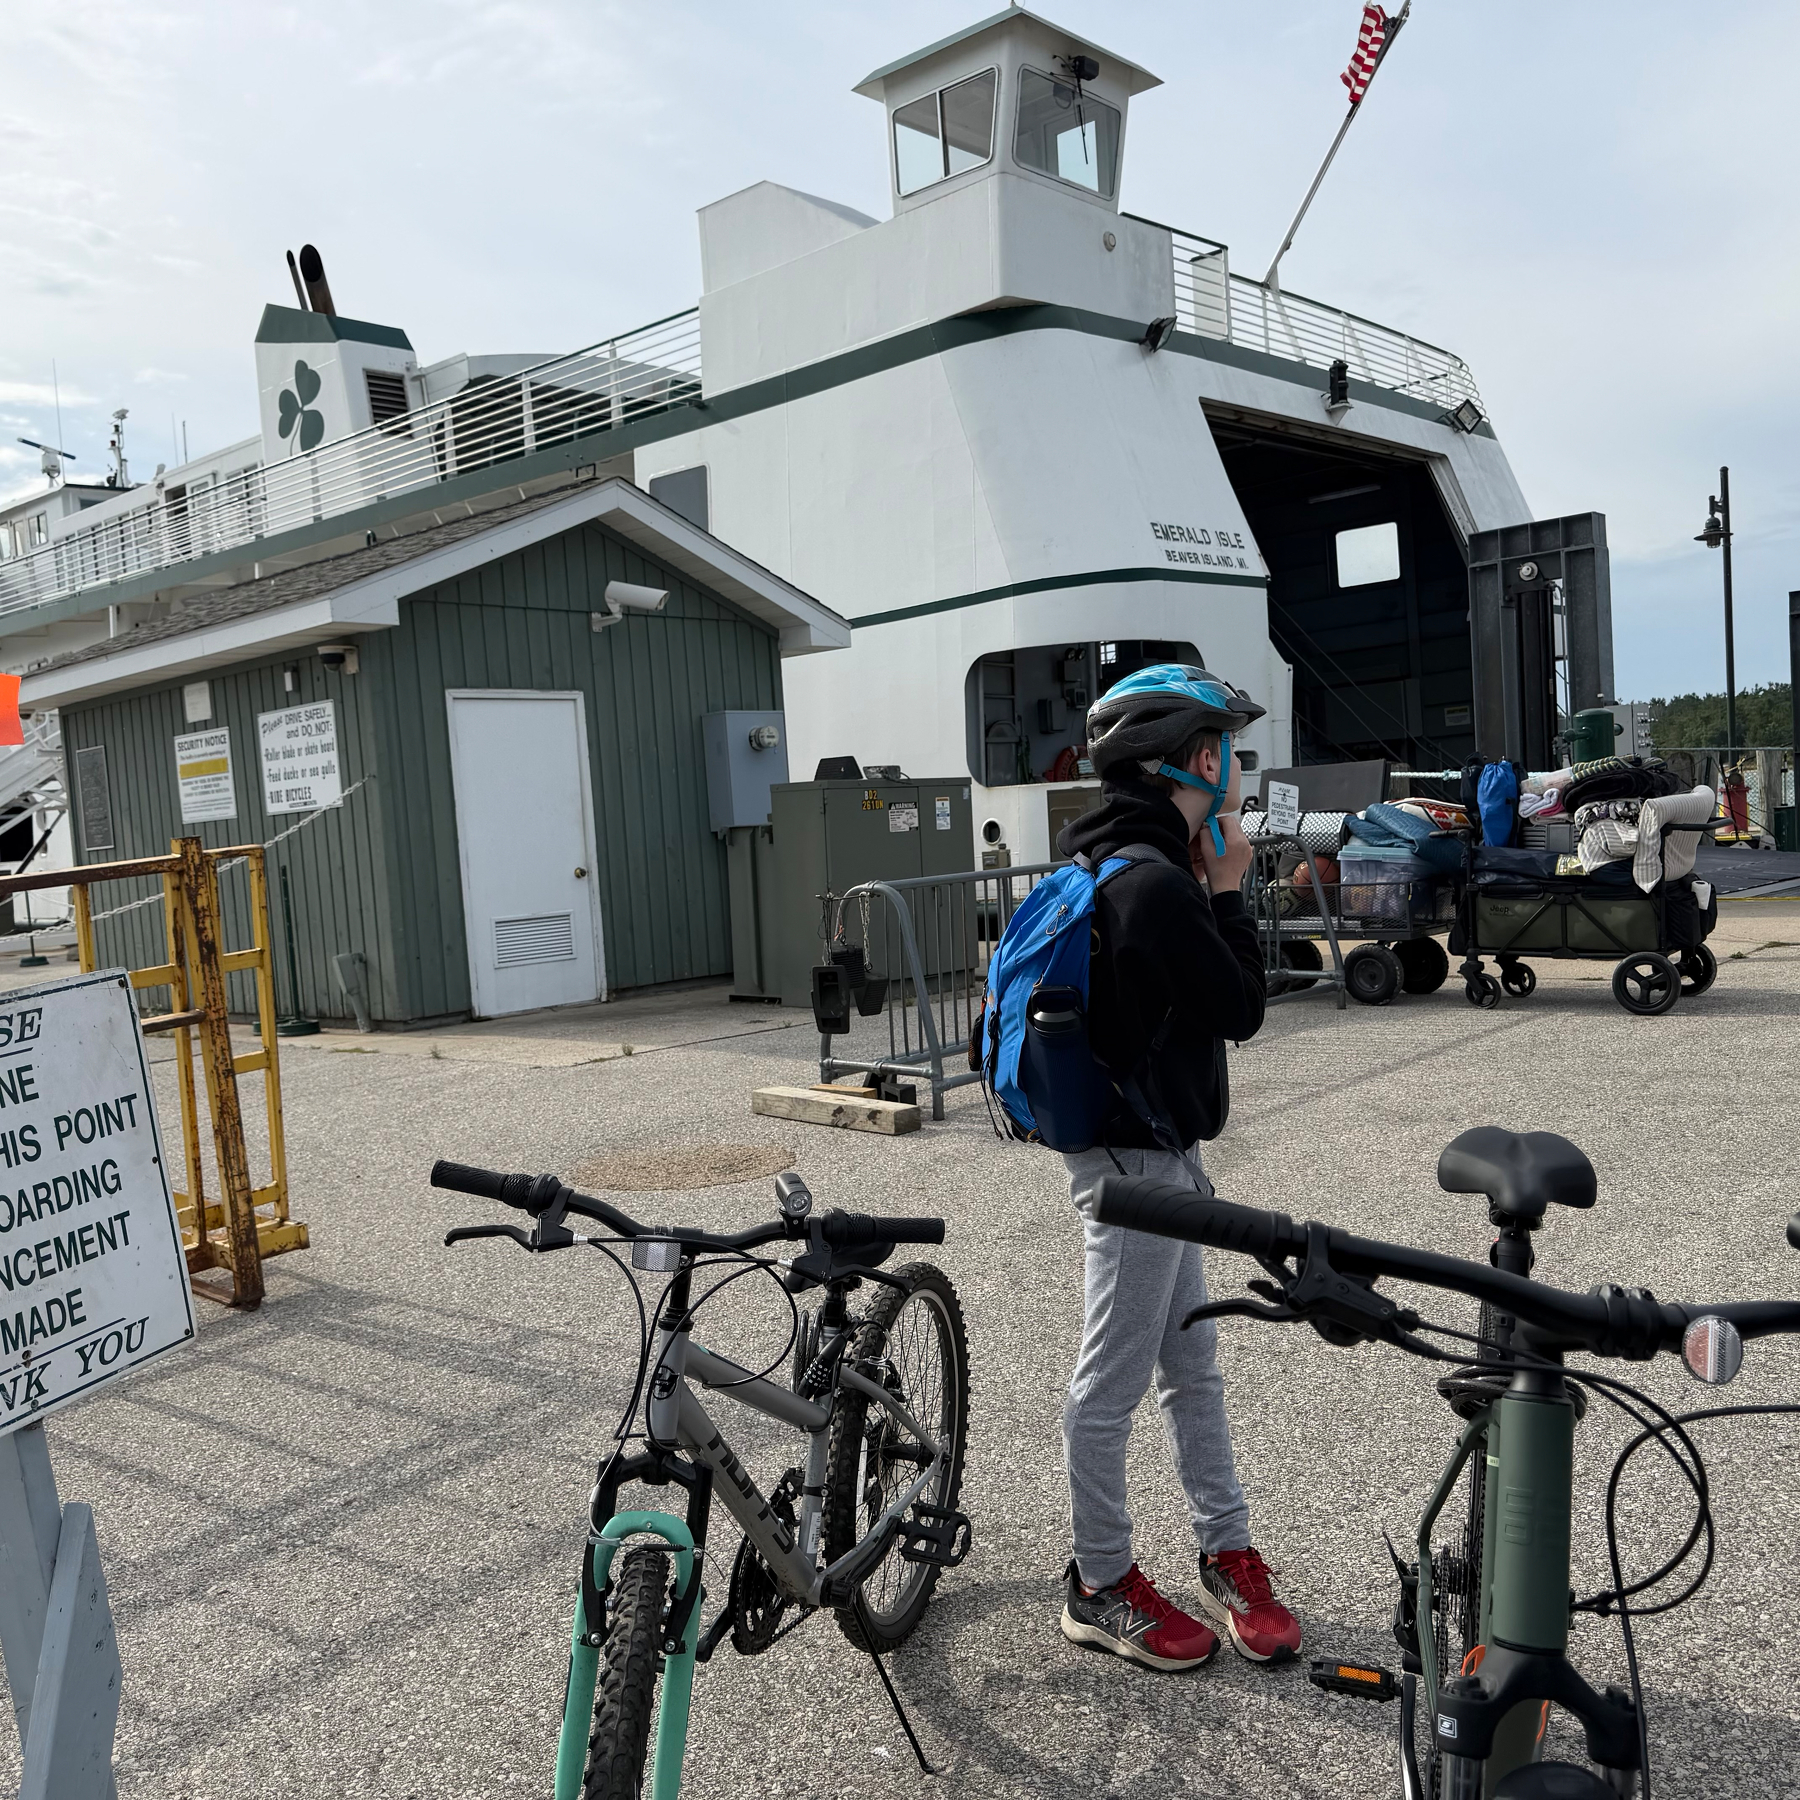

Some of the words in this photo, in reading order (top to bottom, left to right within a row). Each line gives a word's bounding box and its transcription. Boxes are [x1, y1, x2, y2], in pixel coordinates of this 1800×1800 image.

[1150, 522, 1211, 545] EMERALD
[1215, 530, 1245, 549] ISLE
[1165, 550, 1201, 565] BEAVER
[1201, 553, 1237, 569] ISLAND,
[261, 716, 283, 738] Please
[284, 711, 303, 725] DRIVE
[286, 726, 299, 739] and
[301, 724, 313, 736] DO
[315, 721, 333, 734] NOT:
[177, 739, 203, 752] SECURITY
[204, 734, 228, 747] NOTICE
[282, 744, 296, 759] blade
[297, 747, 303, 757] or
[305, 741, 318, 756] skate
[320, 737, 335, 753] board
[283, 765, 299, 780] ducks
[301, 768, 307, 778] or
[309, 766, 320, 777] sea
[321, 760, 336, 780] gulls
[285, 786, 312, 802] BICYCLES
[1271, 809, 1287, 818] BEYOND
[1287, 812, 1296, 820] THIS
[1277, 817, 1289, 825] POINT
[54, 1093, 137, 1151] POINT
[1, 1288, 87, 1355] MADE
[75, 1316, 150, 1378] YOU
